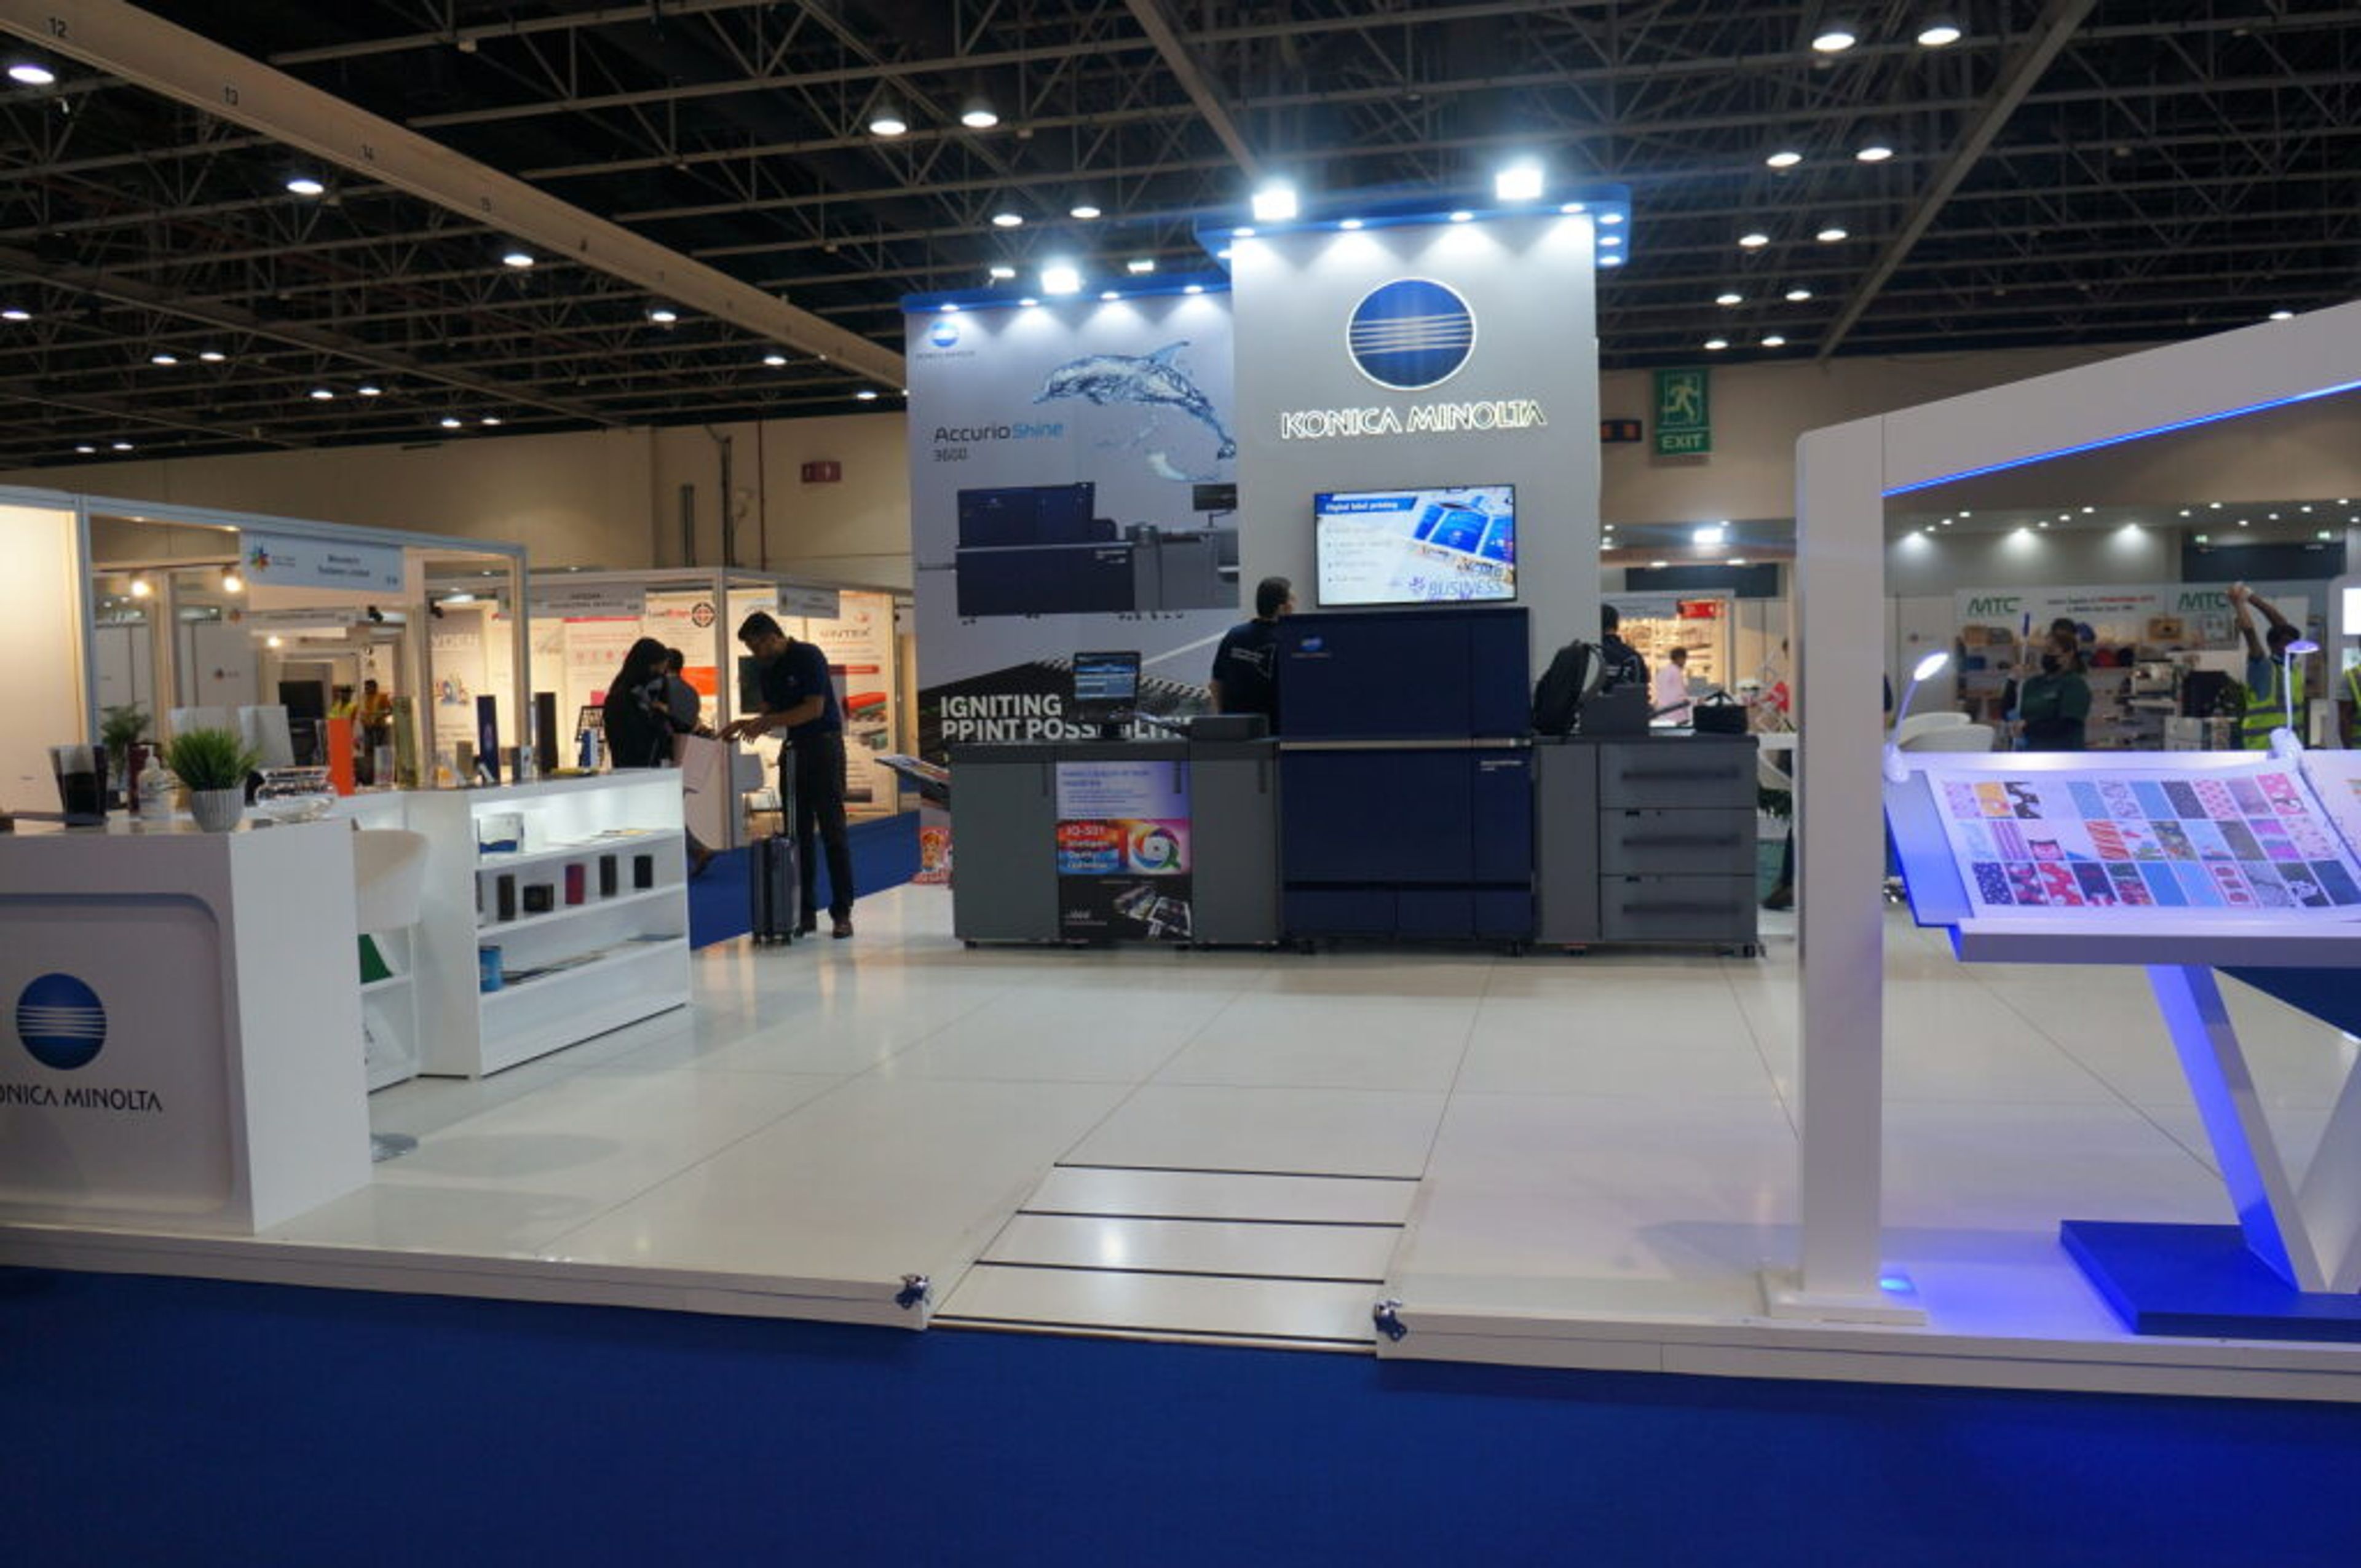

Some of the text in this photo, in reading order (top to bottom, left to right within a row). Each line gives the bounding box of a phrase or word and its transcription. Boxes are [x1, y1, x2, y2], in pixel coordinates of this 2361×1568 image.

[49, 17, 67, 37] 12
[1282, 400, 1547, 438] KONICA MINOLTA
[1662, 434, 1703, 449] EXIT
[1968, 597, 2022, 616] MTC
[940, 694, 1062, 718] IGNITING
[65, 1088, 162, 1112] MINOLTA
